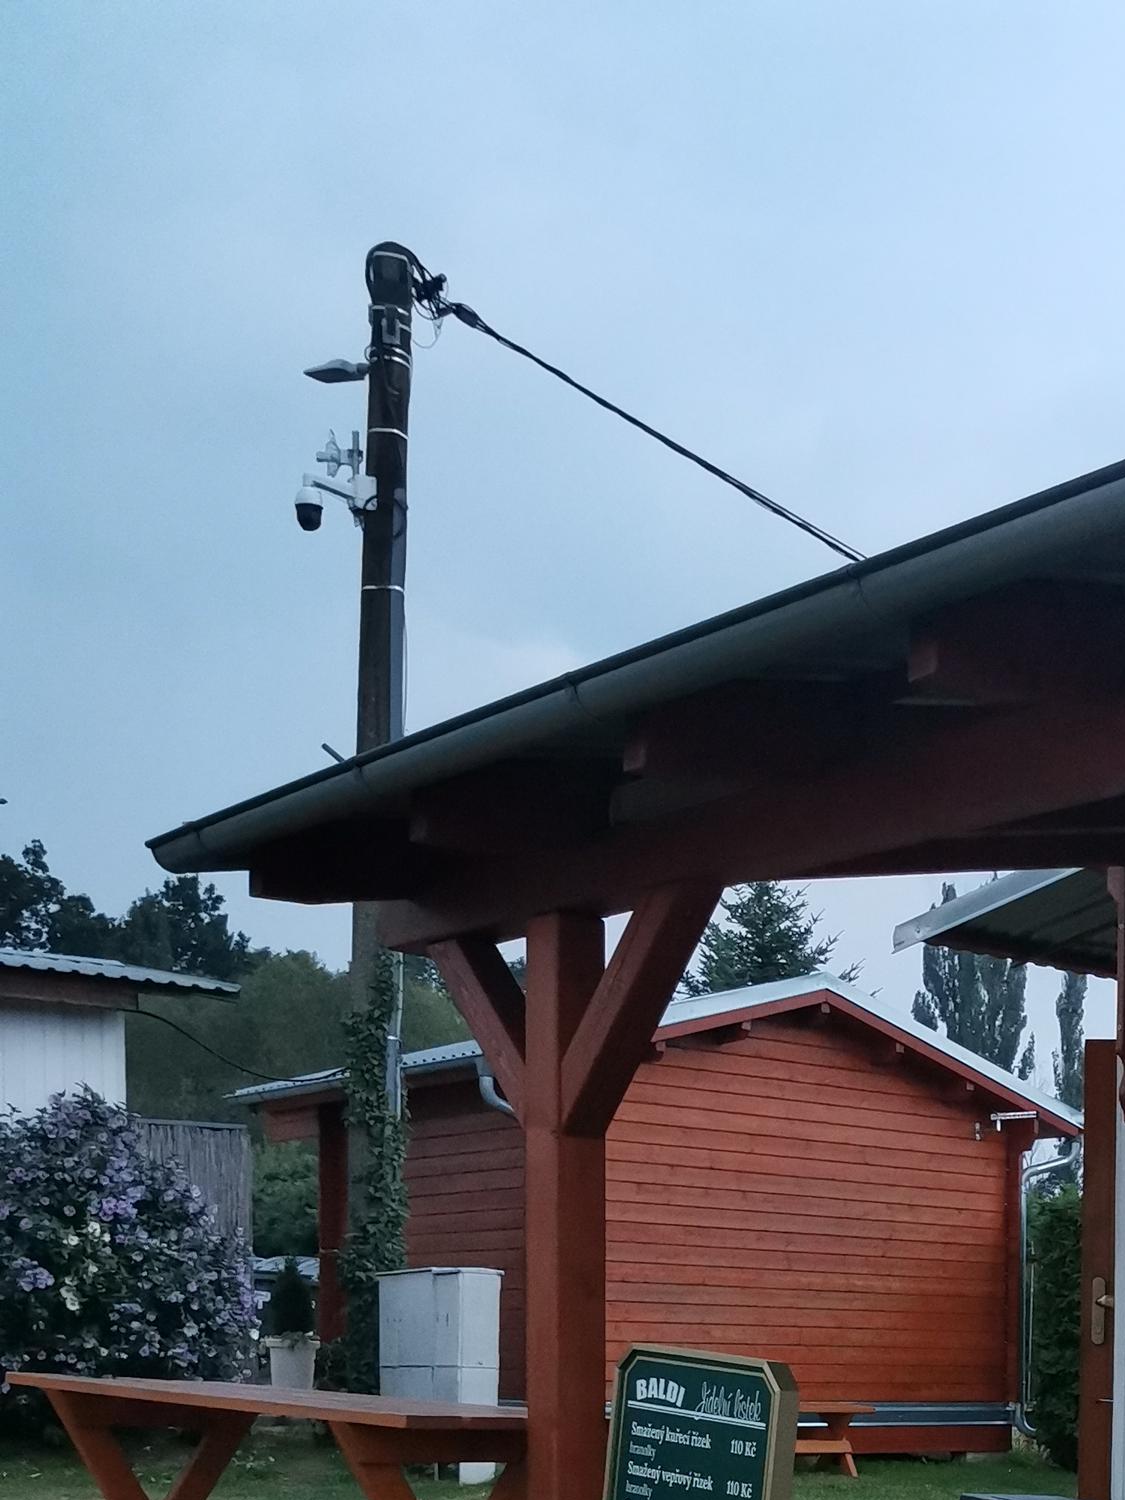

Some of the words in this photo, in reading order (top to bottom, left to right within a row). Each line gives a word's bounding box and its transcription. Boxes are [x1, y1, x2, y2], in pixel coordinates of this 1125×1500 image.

[636, 1377, 686, 1408] BALDI
[694, 1381, 733, 1421] Jídelní
[733, 1389, 762, 1423] lístek
[631, 1421, 666, 1445] Smažený
[665, 1426, 691, 1447] kuřecí
[691, 1430, 712, 1450] řízek
[730, 1438, 744, 1456] 110
[744, 1440, 757, 1458] Kč
[627, 1461, 661, 1485] Smažený
[661, 1468, 693, 1492] vepřový
[692, 1472, 713, 1492] řízek
[726, 1480, 740, 1496] 110
[740, 1482, 753, 1499] Kč
